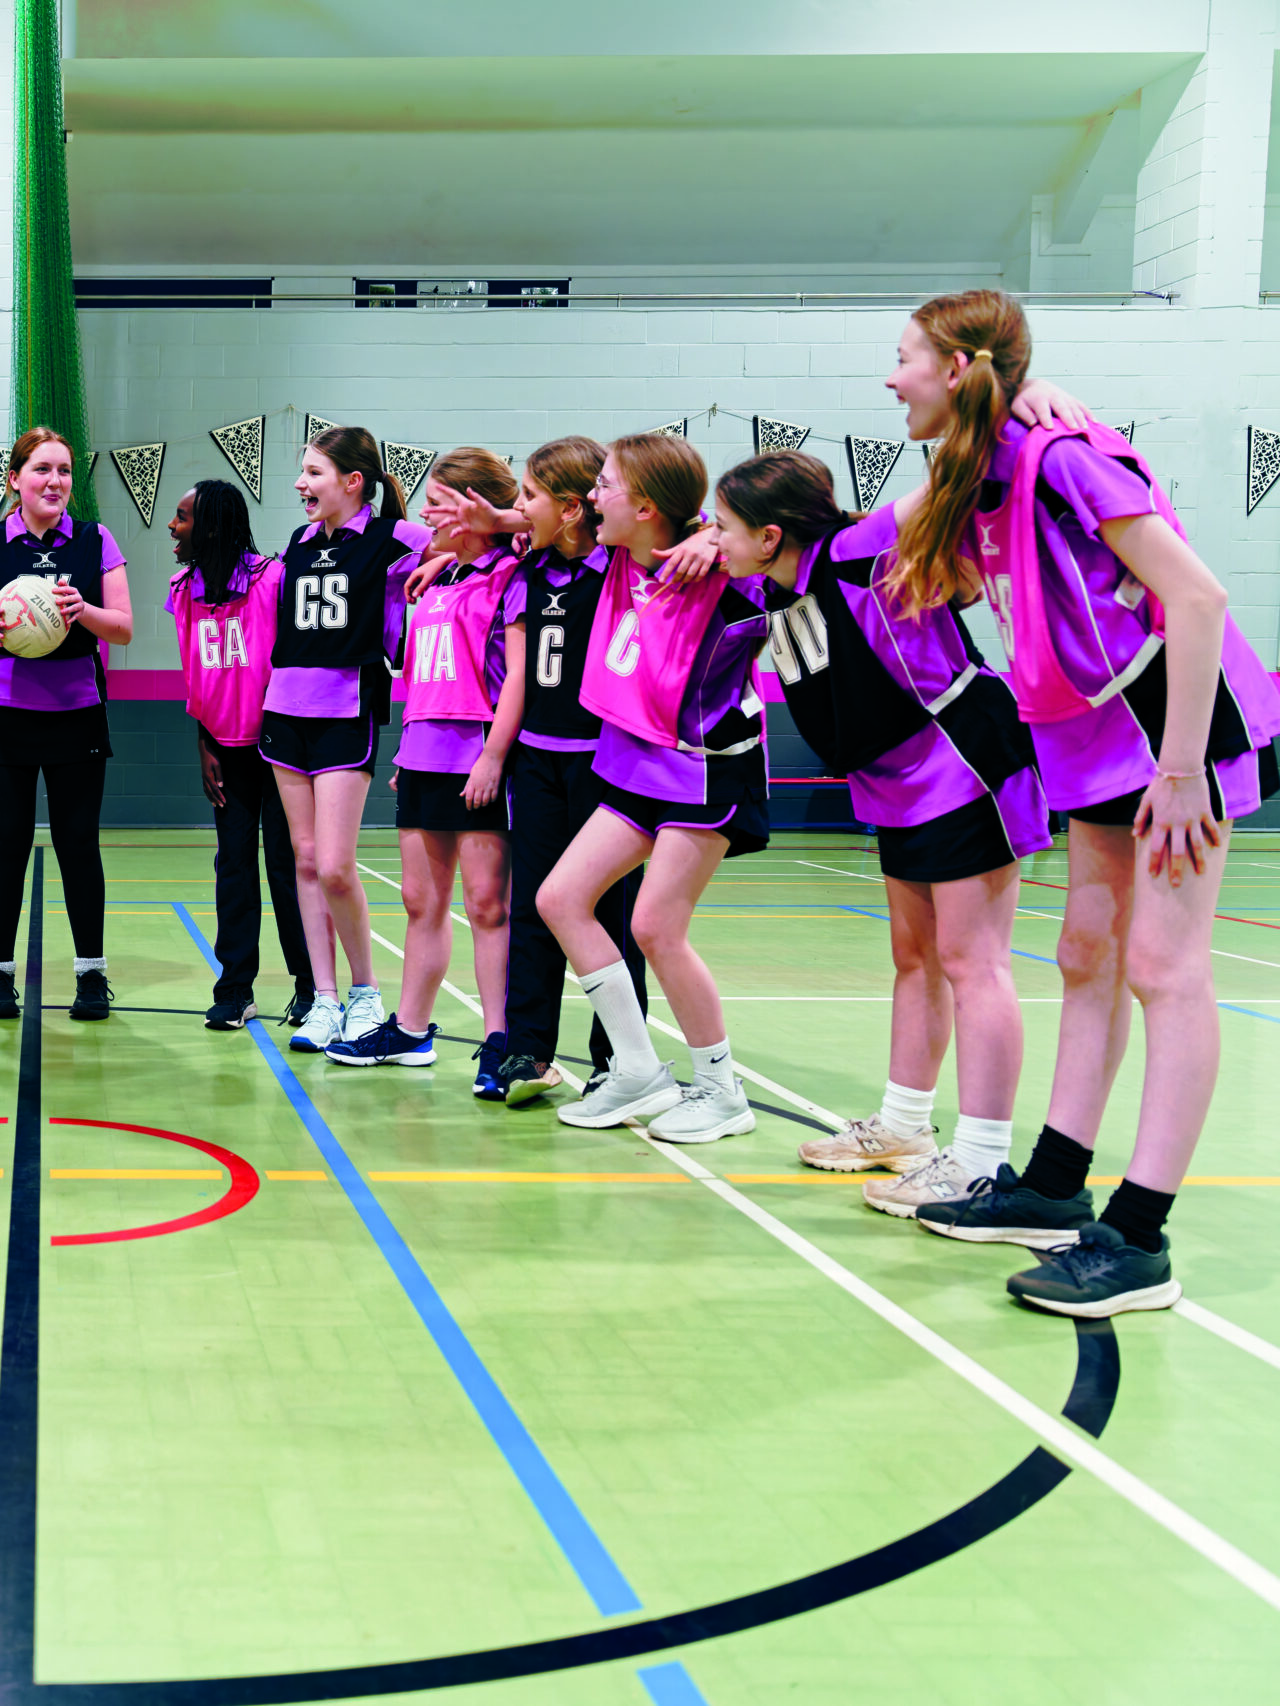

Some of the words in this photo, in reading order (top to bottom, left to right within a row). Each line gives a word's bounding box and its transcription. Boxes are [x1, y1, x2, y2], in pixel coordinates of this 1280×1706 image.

[30, 594, 61, 629] ZILAND
[295, 573, 348, 630] GS
[198, 616, 249, 669] GA
[413, 622, 456, 684] WA
[536, 625, 564, 687] C
[605, 608, 640, 677] C
